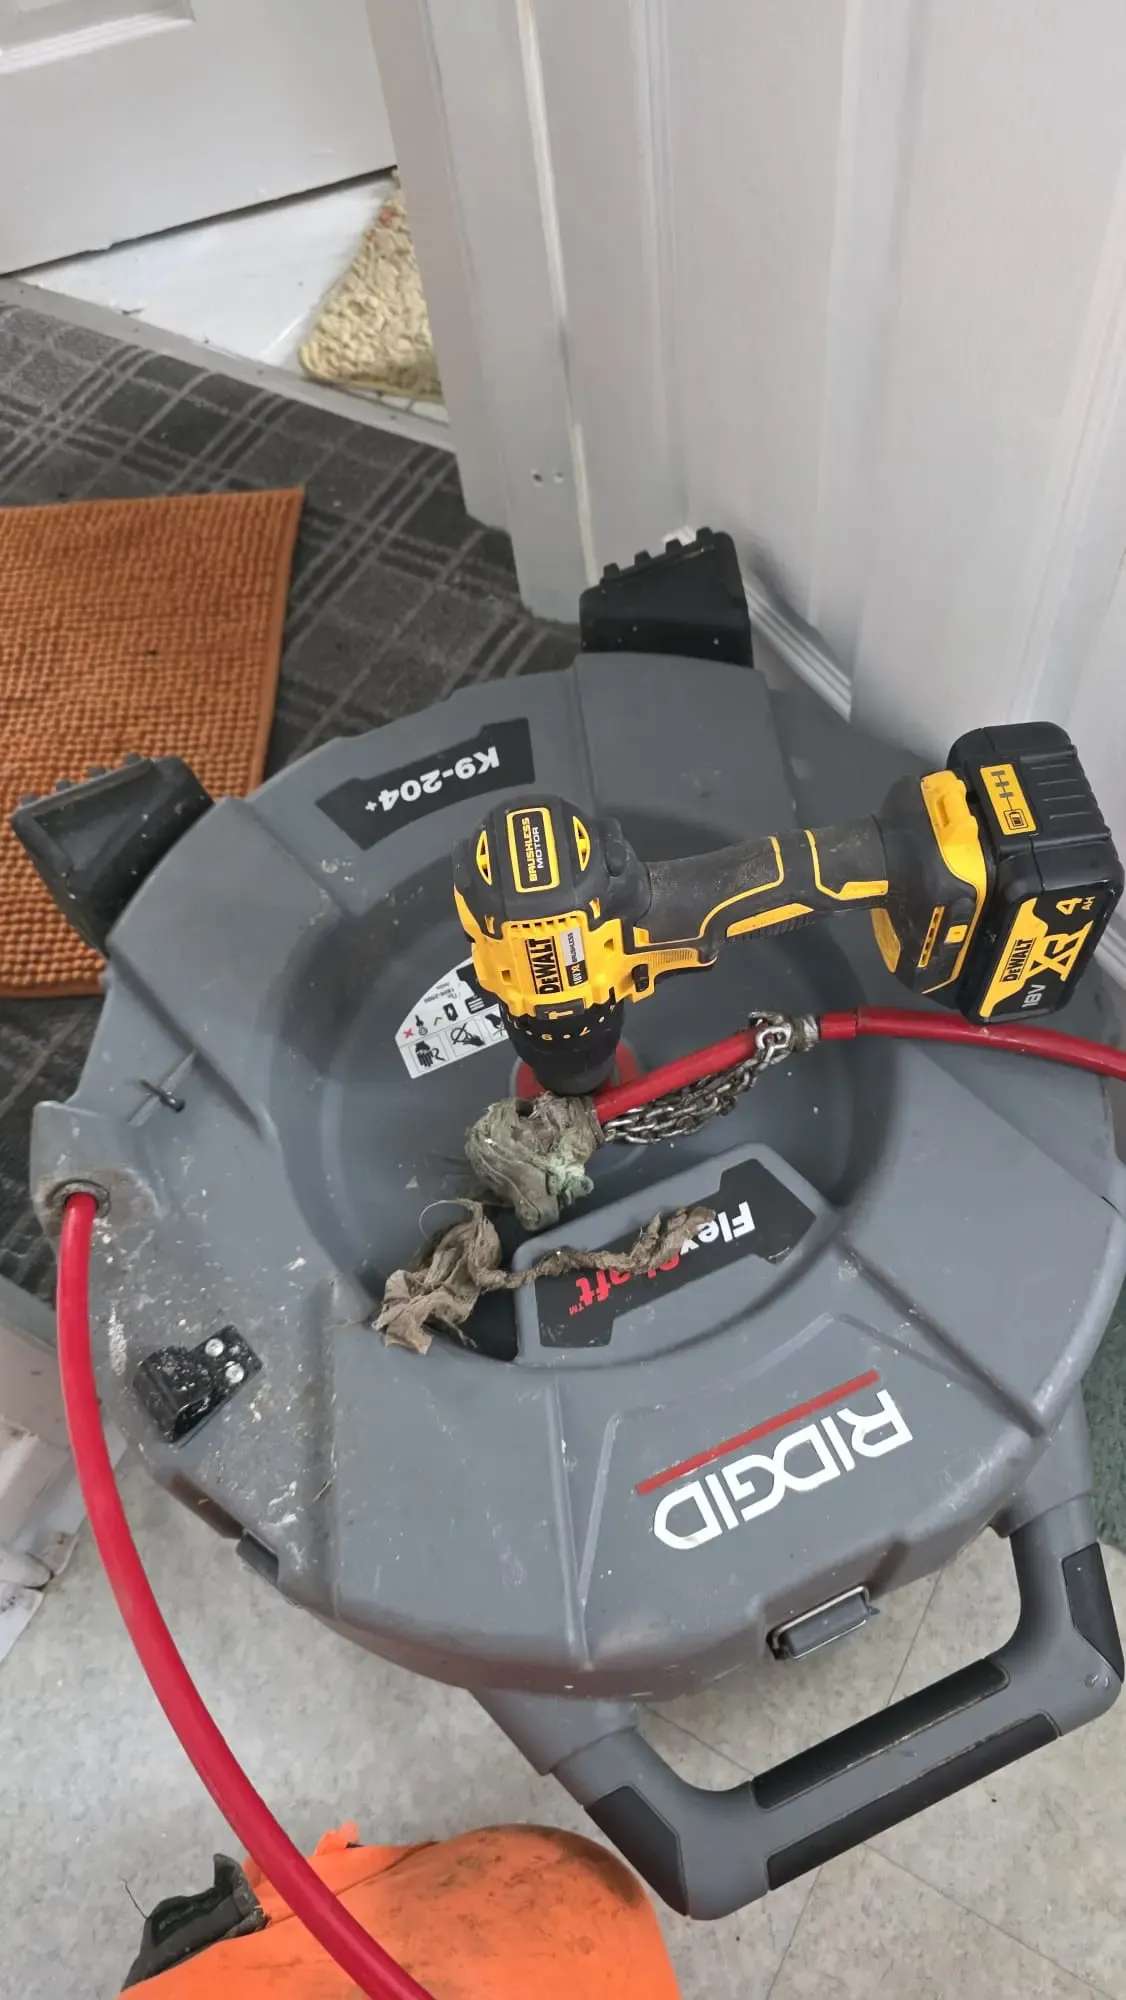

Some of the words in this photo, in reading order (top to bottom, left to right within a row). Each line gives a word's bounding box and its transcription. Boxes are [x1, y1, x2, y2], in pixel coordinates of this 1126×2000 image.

[365, 746, 500, 812] K9-204+
[521, 817, 538, 882] BRUSHLESS
[532, 826, 544, 869] MOTOR
[1055, 897, 1083, 915] 4
[527, 938, 561, 994] DEWALT
[1002, 938, 1034, 983] DEWALT
[1022, 984, 1046, 1008] 18V
[654, 1388, 913, 1550] RIDGID
